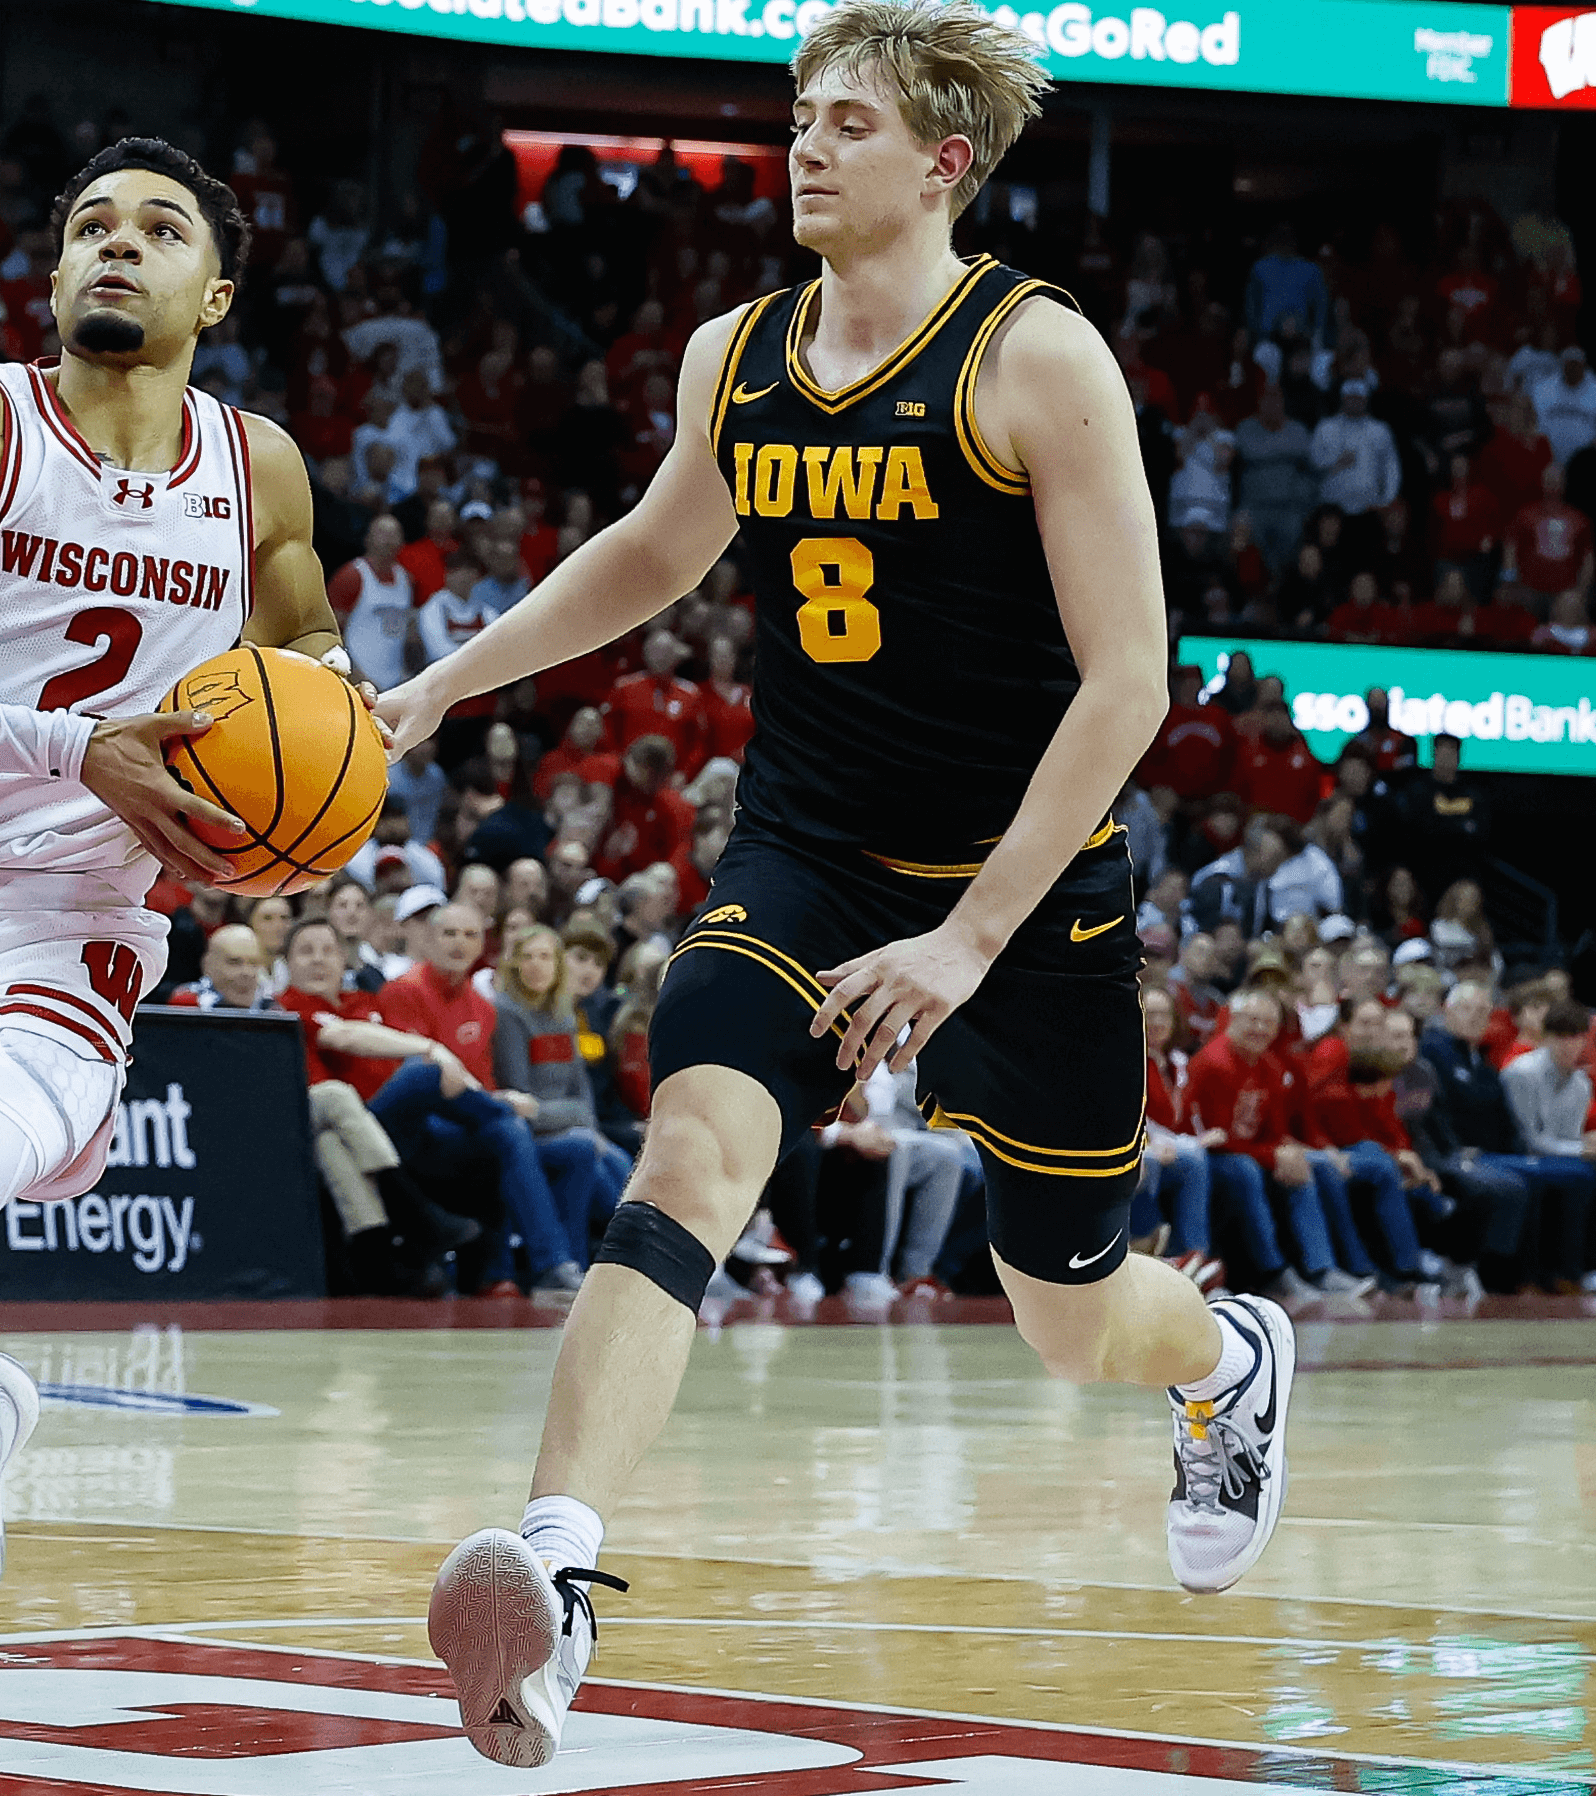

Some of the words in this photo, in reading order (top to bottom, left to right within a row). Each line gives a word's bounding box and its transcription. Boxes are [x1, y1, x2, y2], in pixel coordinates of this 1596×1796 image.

[734, 442, 940, 521] IOWA
[1, 529, 230, 612] WISCONSIN
[789, 537, 882, 663] 8
[36, 606, 144, 713] 2
